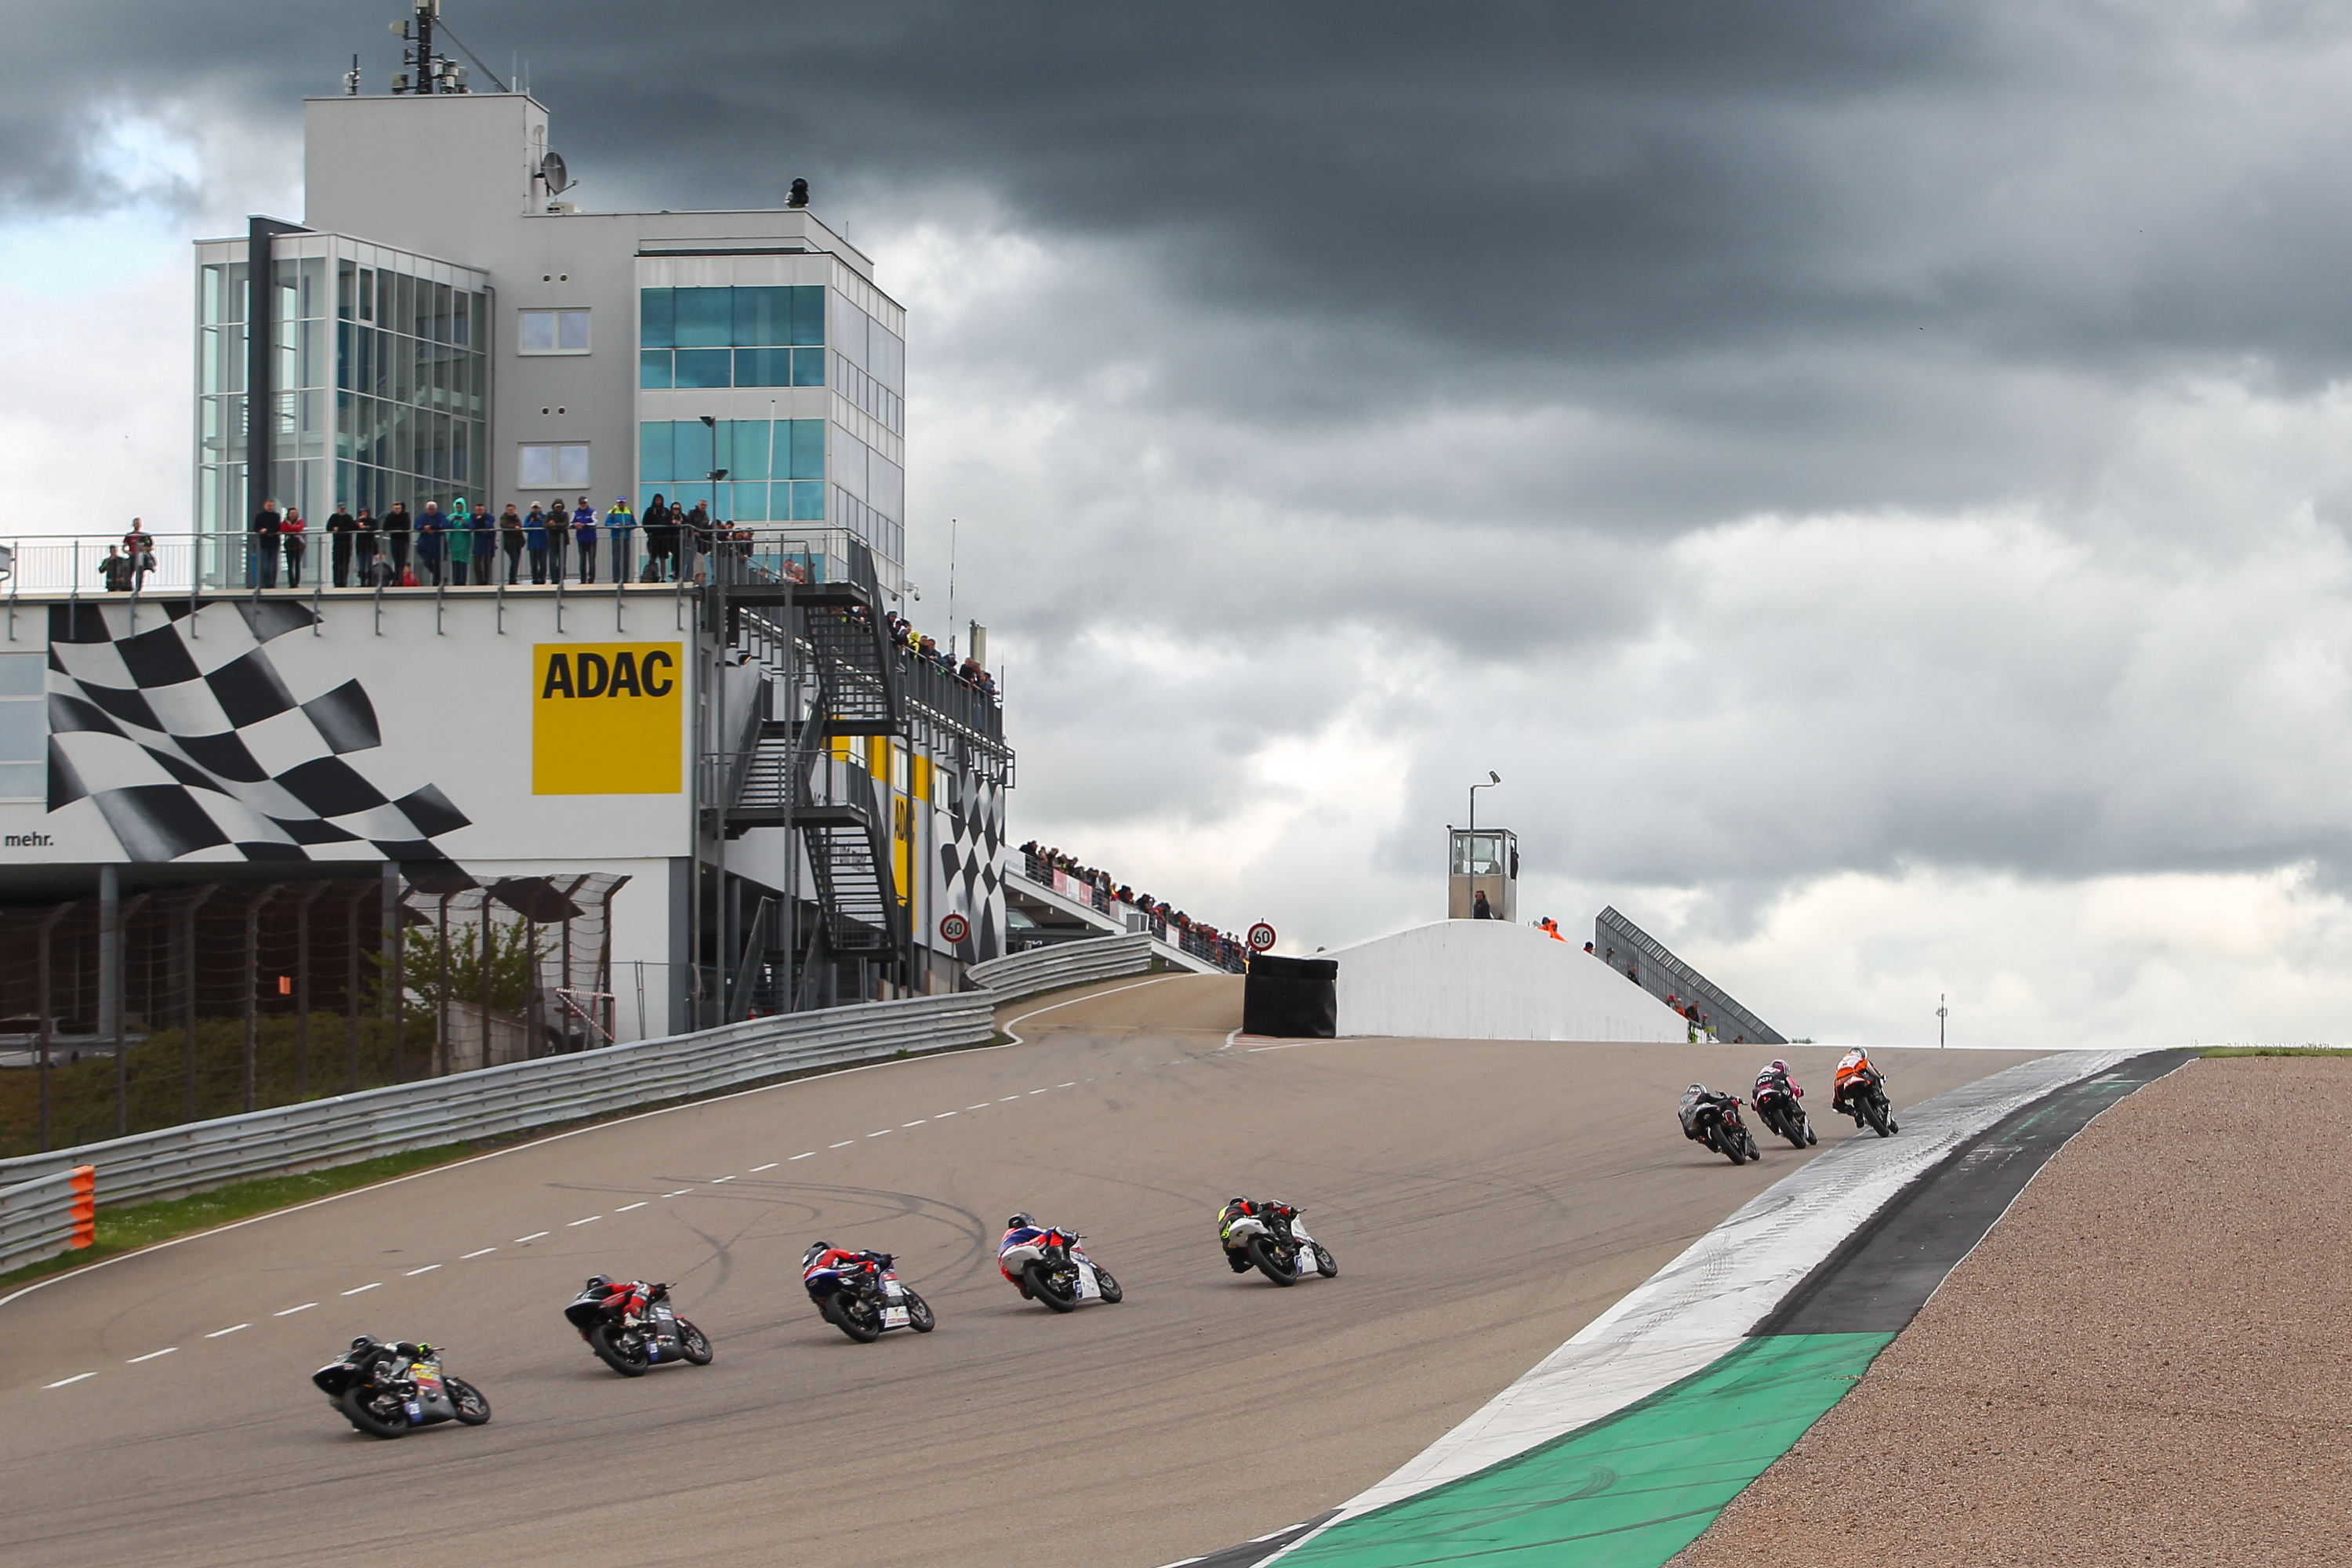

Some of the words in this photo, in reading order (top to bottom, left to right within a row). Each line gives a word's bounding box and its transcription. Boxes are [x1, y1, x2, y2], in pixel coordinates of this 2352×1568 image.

[542, 650, 673, 699] ADAC
[5, 831, 54, 847] mehr.
[946, 922, 962, 935] 60
[1254, 930, 1270, 944] 60
